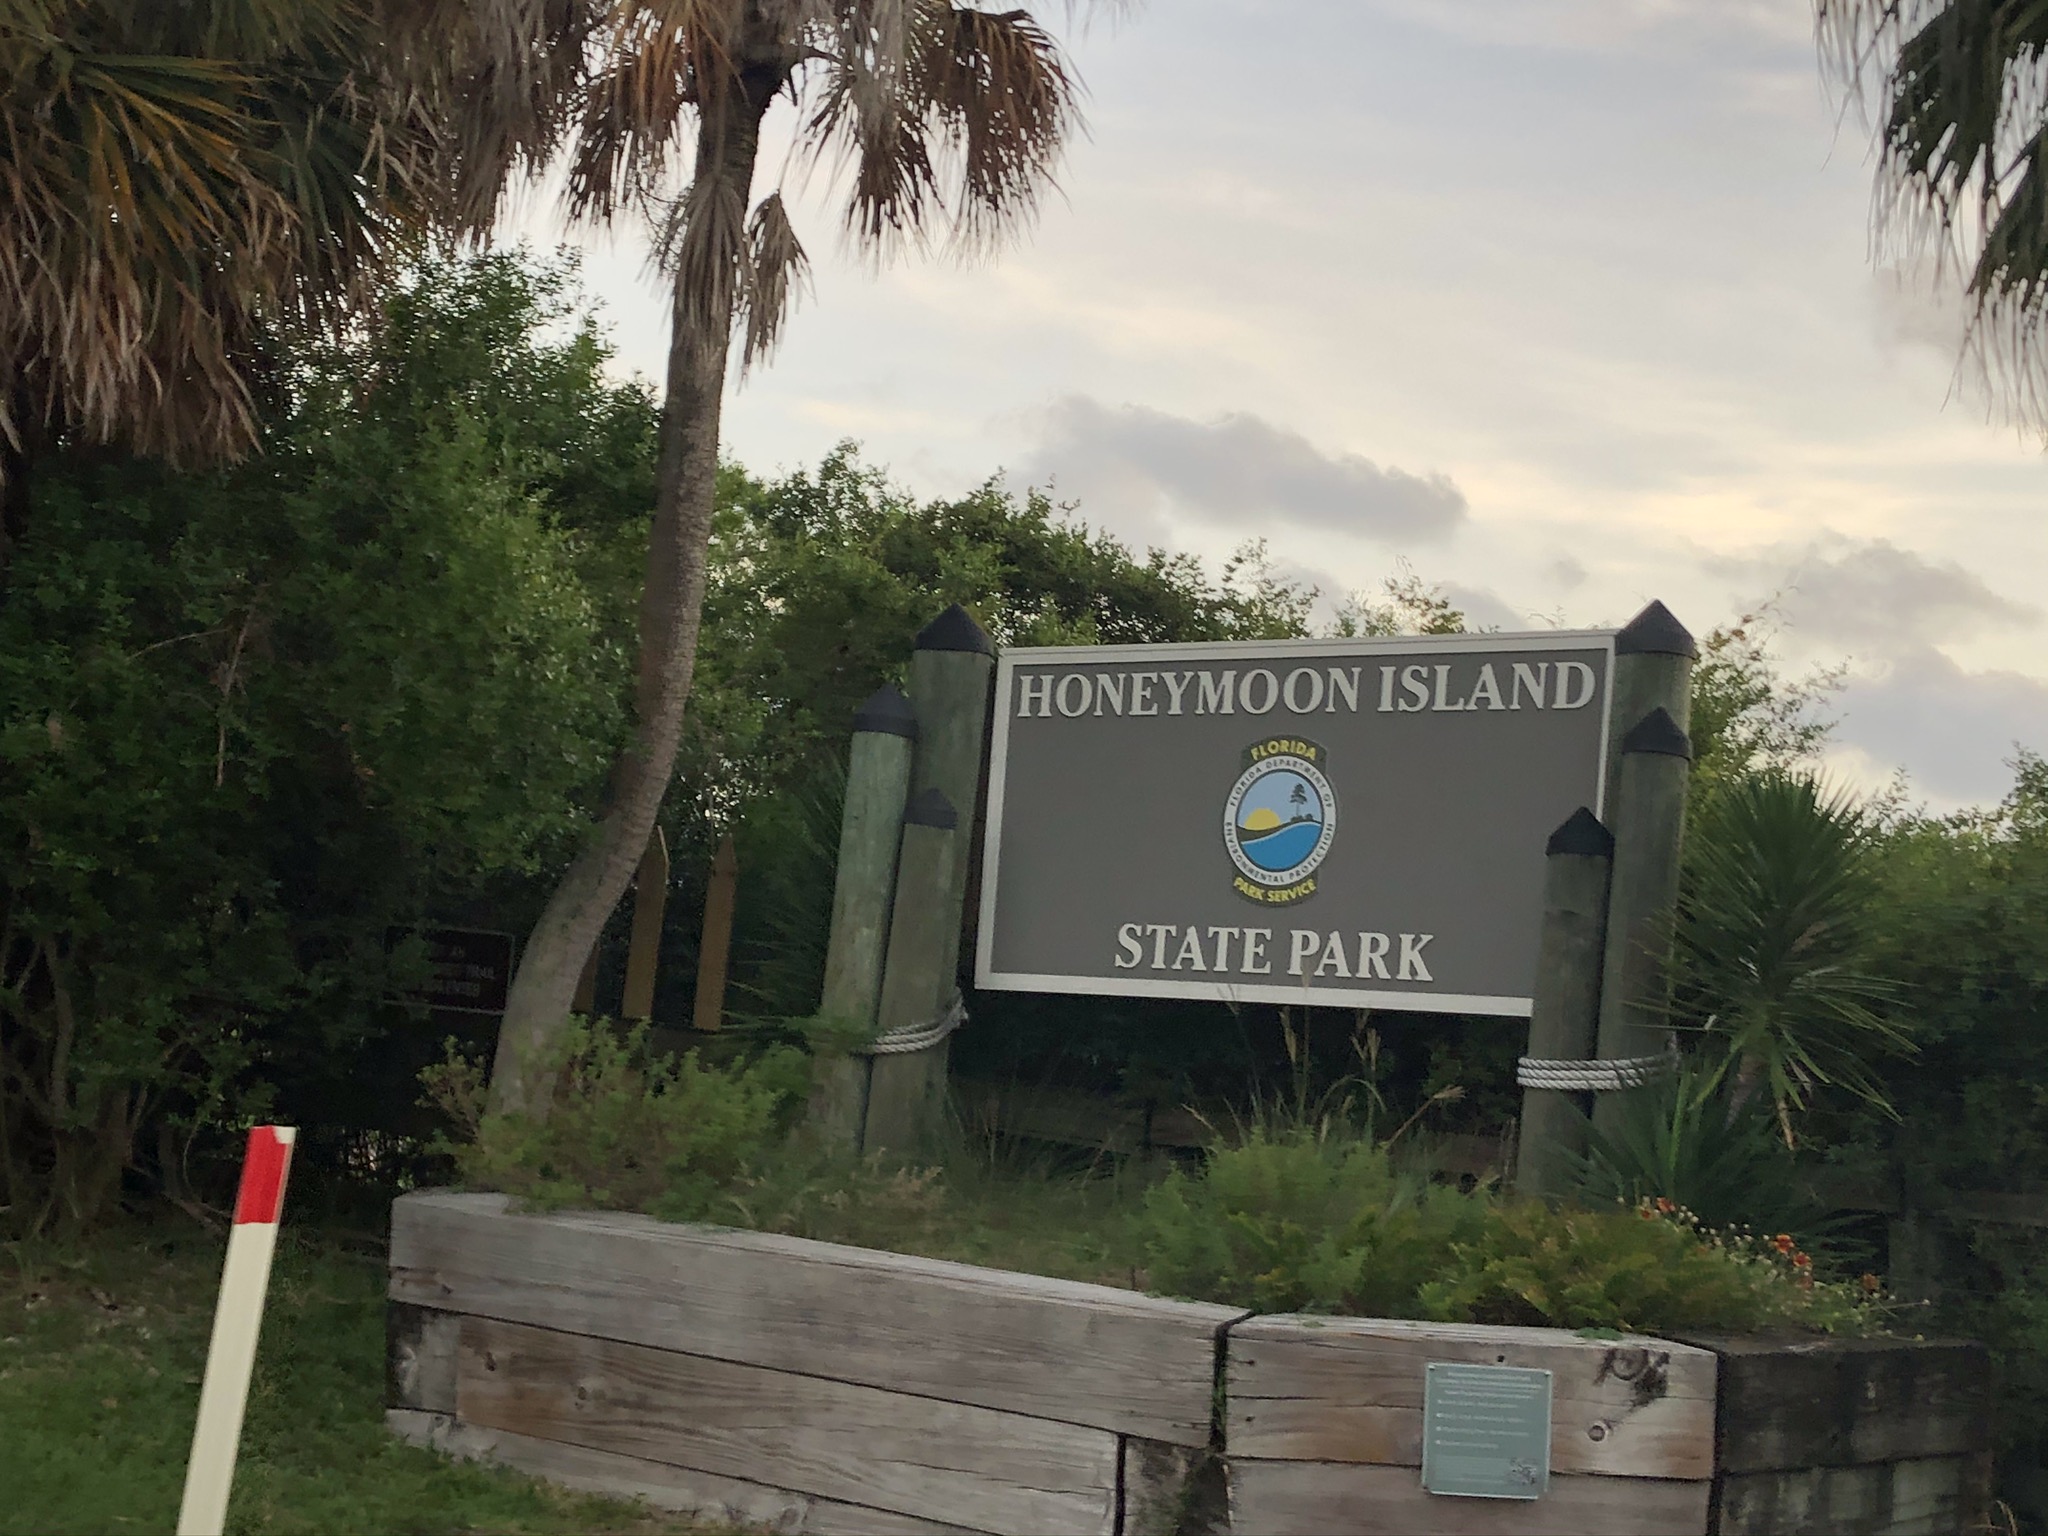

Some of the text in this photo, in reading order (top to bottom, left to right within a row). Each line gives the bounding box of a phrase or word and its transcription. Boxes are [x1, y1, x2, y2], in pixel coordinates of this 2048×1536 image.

[1017, 662, 1595, 717] HONEYMOON ISLAND
[1251, 739, 1317, 761] FLORIDA
[1230, 758, 1333, 808] FLORIDA DEPARTMENT OF
[1289, 823, 1334, 880] PROTECTION
[1234, 877, 1317, 902] PARK SERVICE
[1114, 923, 1434, 981] STATE PARK
